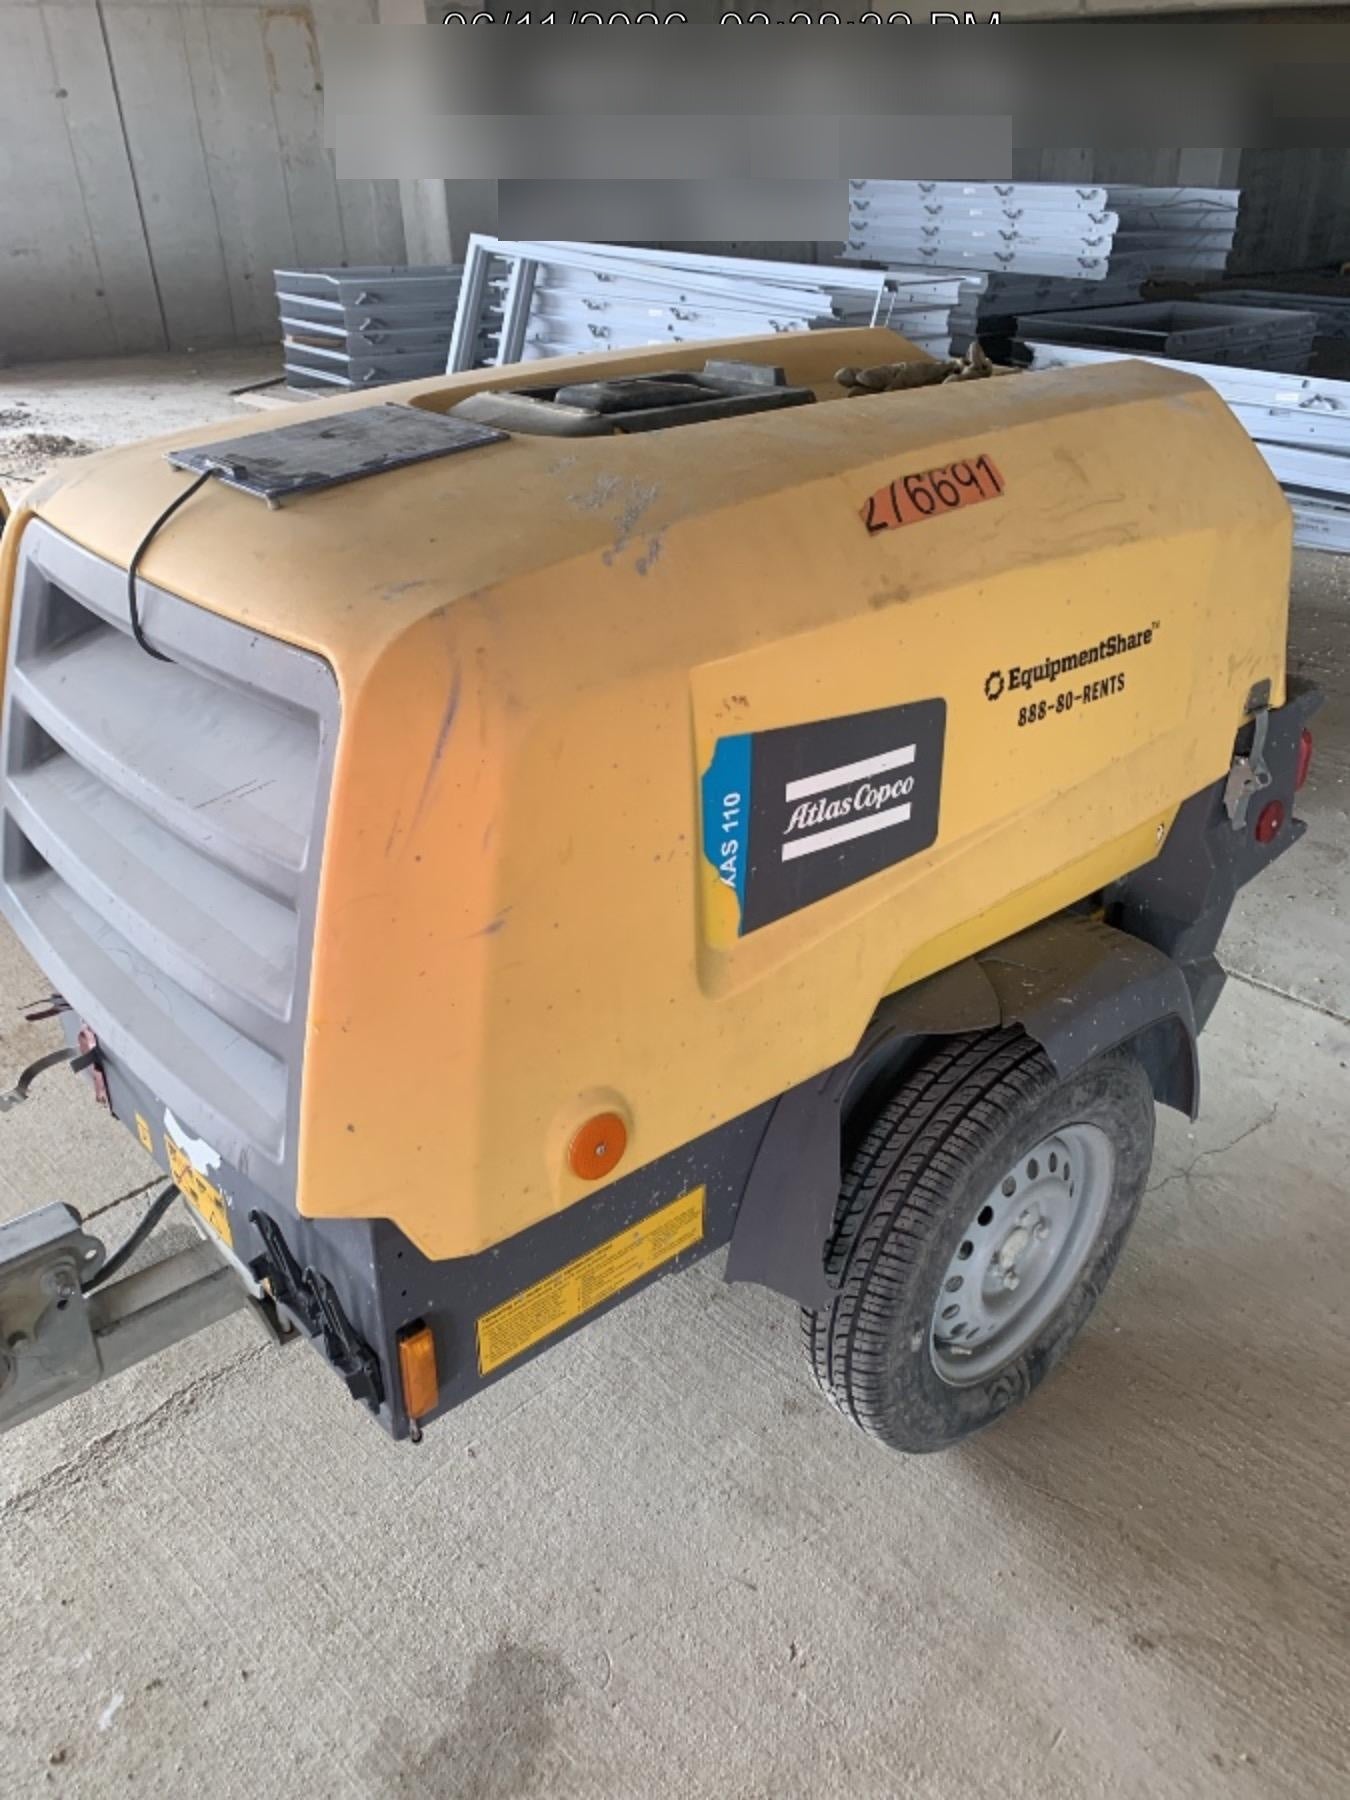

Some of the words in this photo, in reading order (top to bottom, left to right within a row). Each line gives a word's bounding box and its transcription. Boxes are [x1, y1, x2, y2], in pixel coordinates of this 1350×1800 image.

[1008, 628, 1152, 691] EquipmentShare
[1017, 672, 1126, 727] 888-80-RENTS
[721, 792, 741, 833] 110
[783, 796, 852, 835] Atlas
[853, 776, 915, 810] Copco
